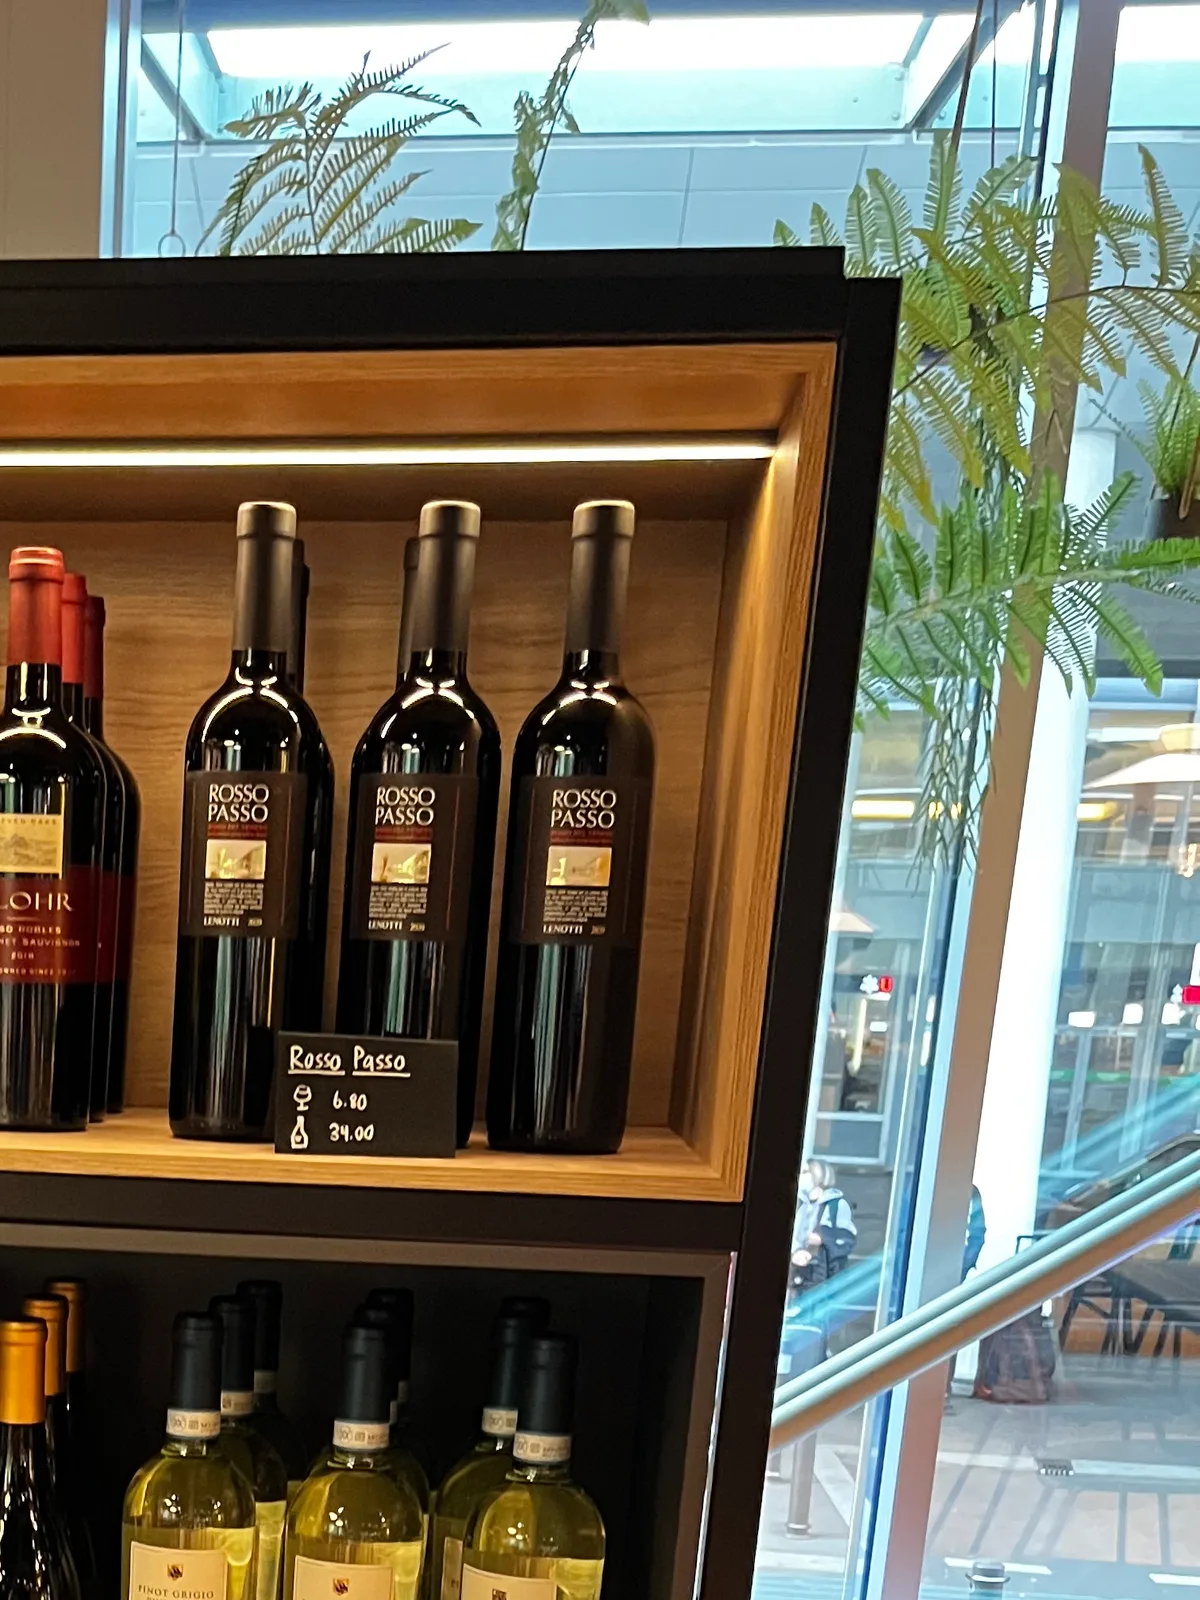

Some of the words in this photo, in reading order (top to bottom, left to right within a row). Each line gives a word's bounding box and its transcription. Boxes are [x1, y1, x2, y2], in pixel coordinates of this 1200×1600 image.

[209, 783, 270, 804] ROSSO
[376, 786, 436, 807] ROSSO
[552, 788, 617, 809] ROSSO
[208, 803, 269, 823] PASSO
[374, 806, 434, 826] PASSO
[550, 809, 615, 829] PASSO
[289, 1045, 343, 1071] Rosso
[353, 1045, 407, 1071] Passo
[332, 1092, 368, 1110] 6.80
[329, 1123, 375, 1142] 34.00
[138, 1585, 168, 1597] PINOT
[172, 1590, 214, 1600] GRIGIO
